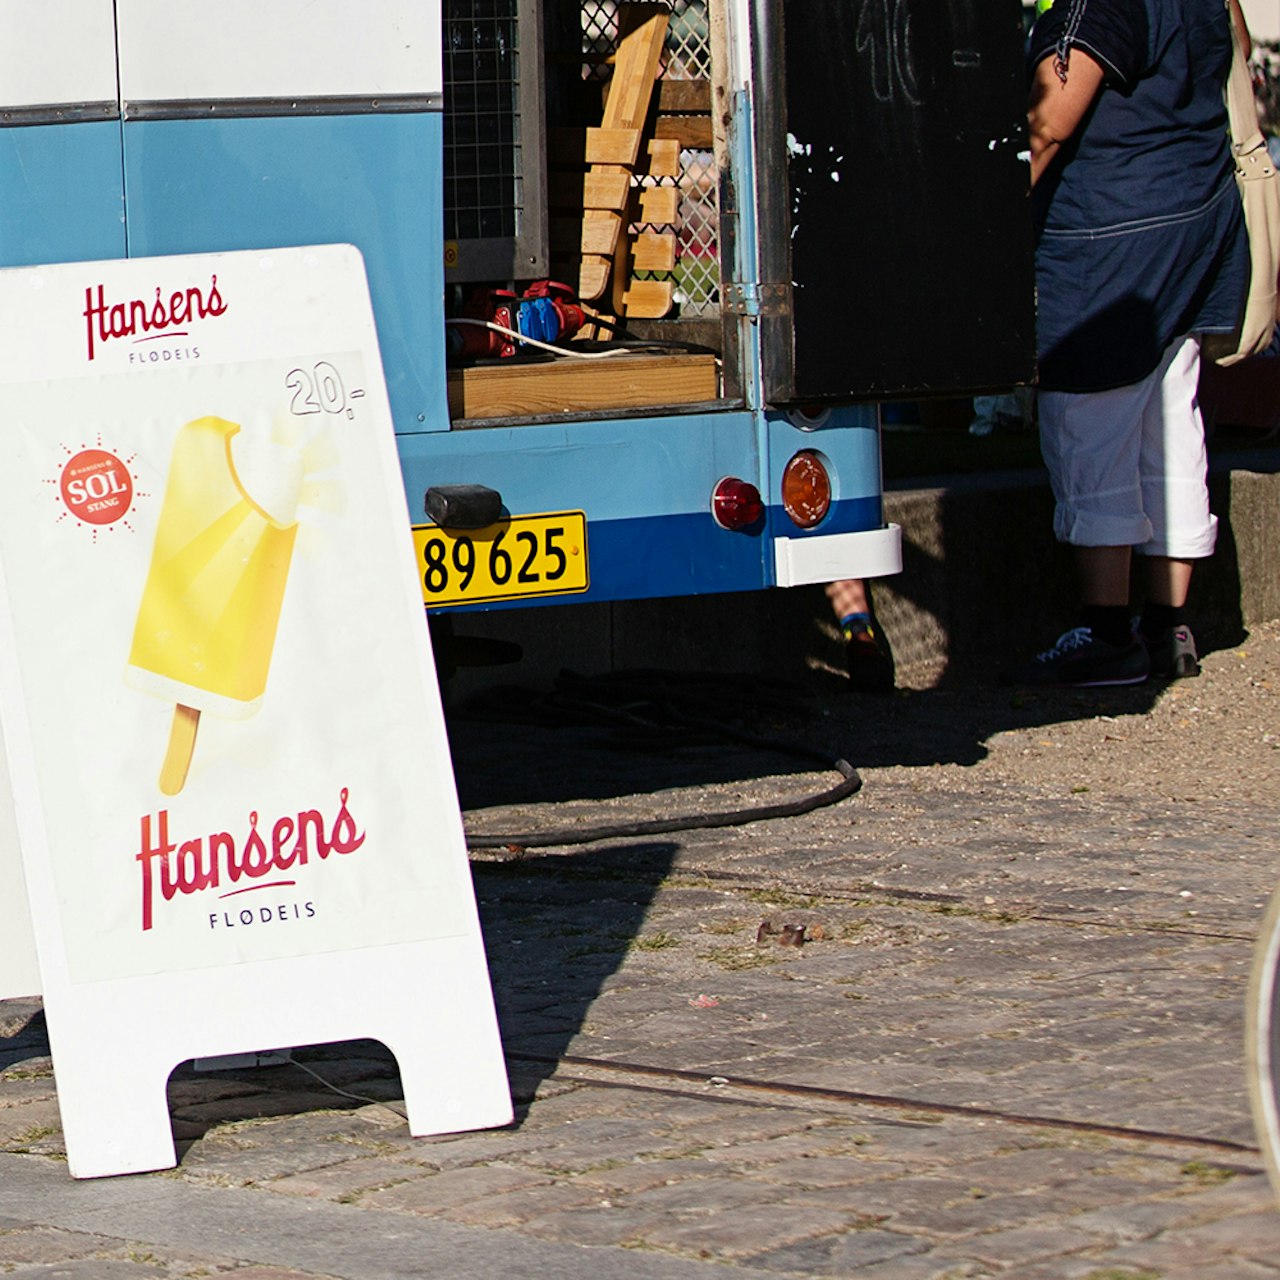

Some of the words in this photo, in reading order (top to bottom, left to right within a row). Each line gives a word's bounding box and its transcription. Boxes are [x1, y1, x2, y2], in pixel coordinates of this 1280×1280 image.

[83, 274, 228, 361] Hansens
[129, 347, 200, 364] FLØDEIS
[285, 361, 366, 420] 20,-
[67, 470, 128, 505] SOL
[87, 497, 120, 513] STANG
[424, 536, 475, 593] 89
[489, 527, 567, 585] 625
[136, 787, 366, 931] Hansens
[209, 901, 316, 929] FLØDEIS
